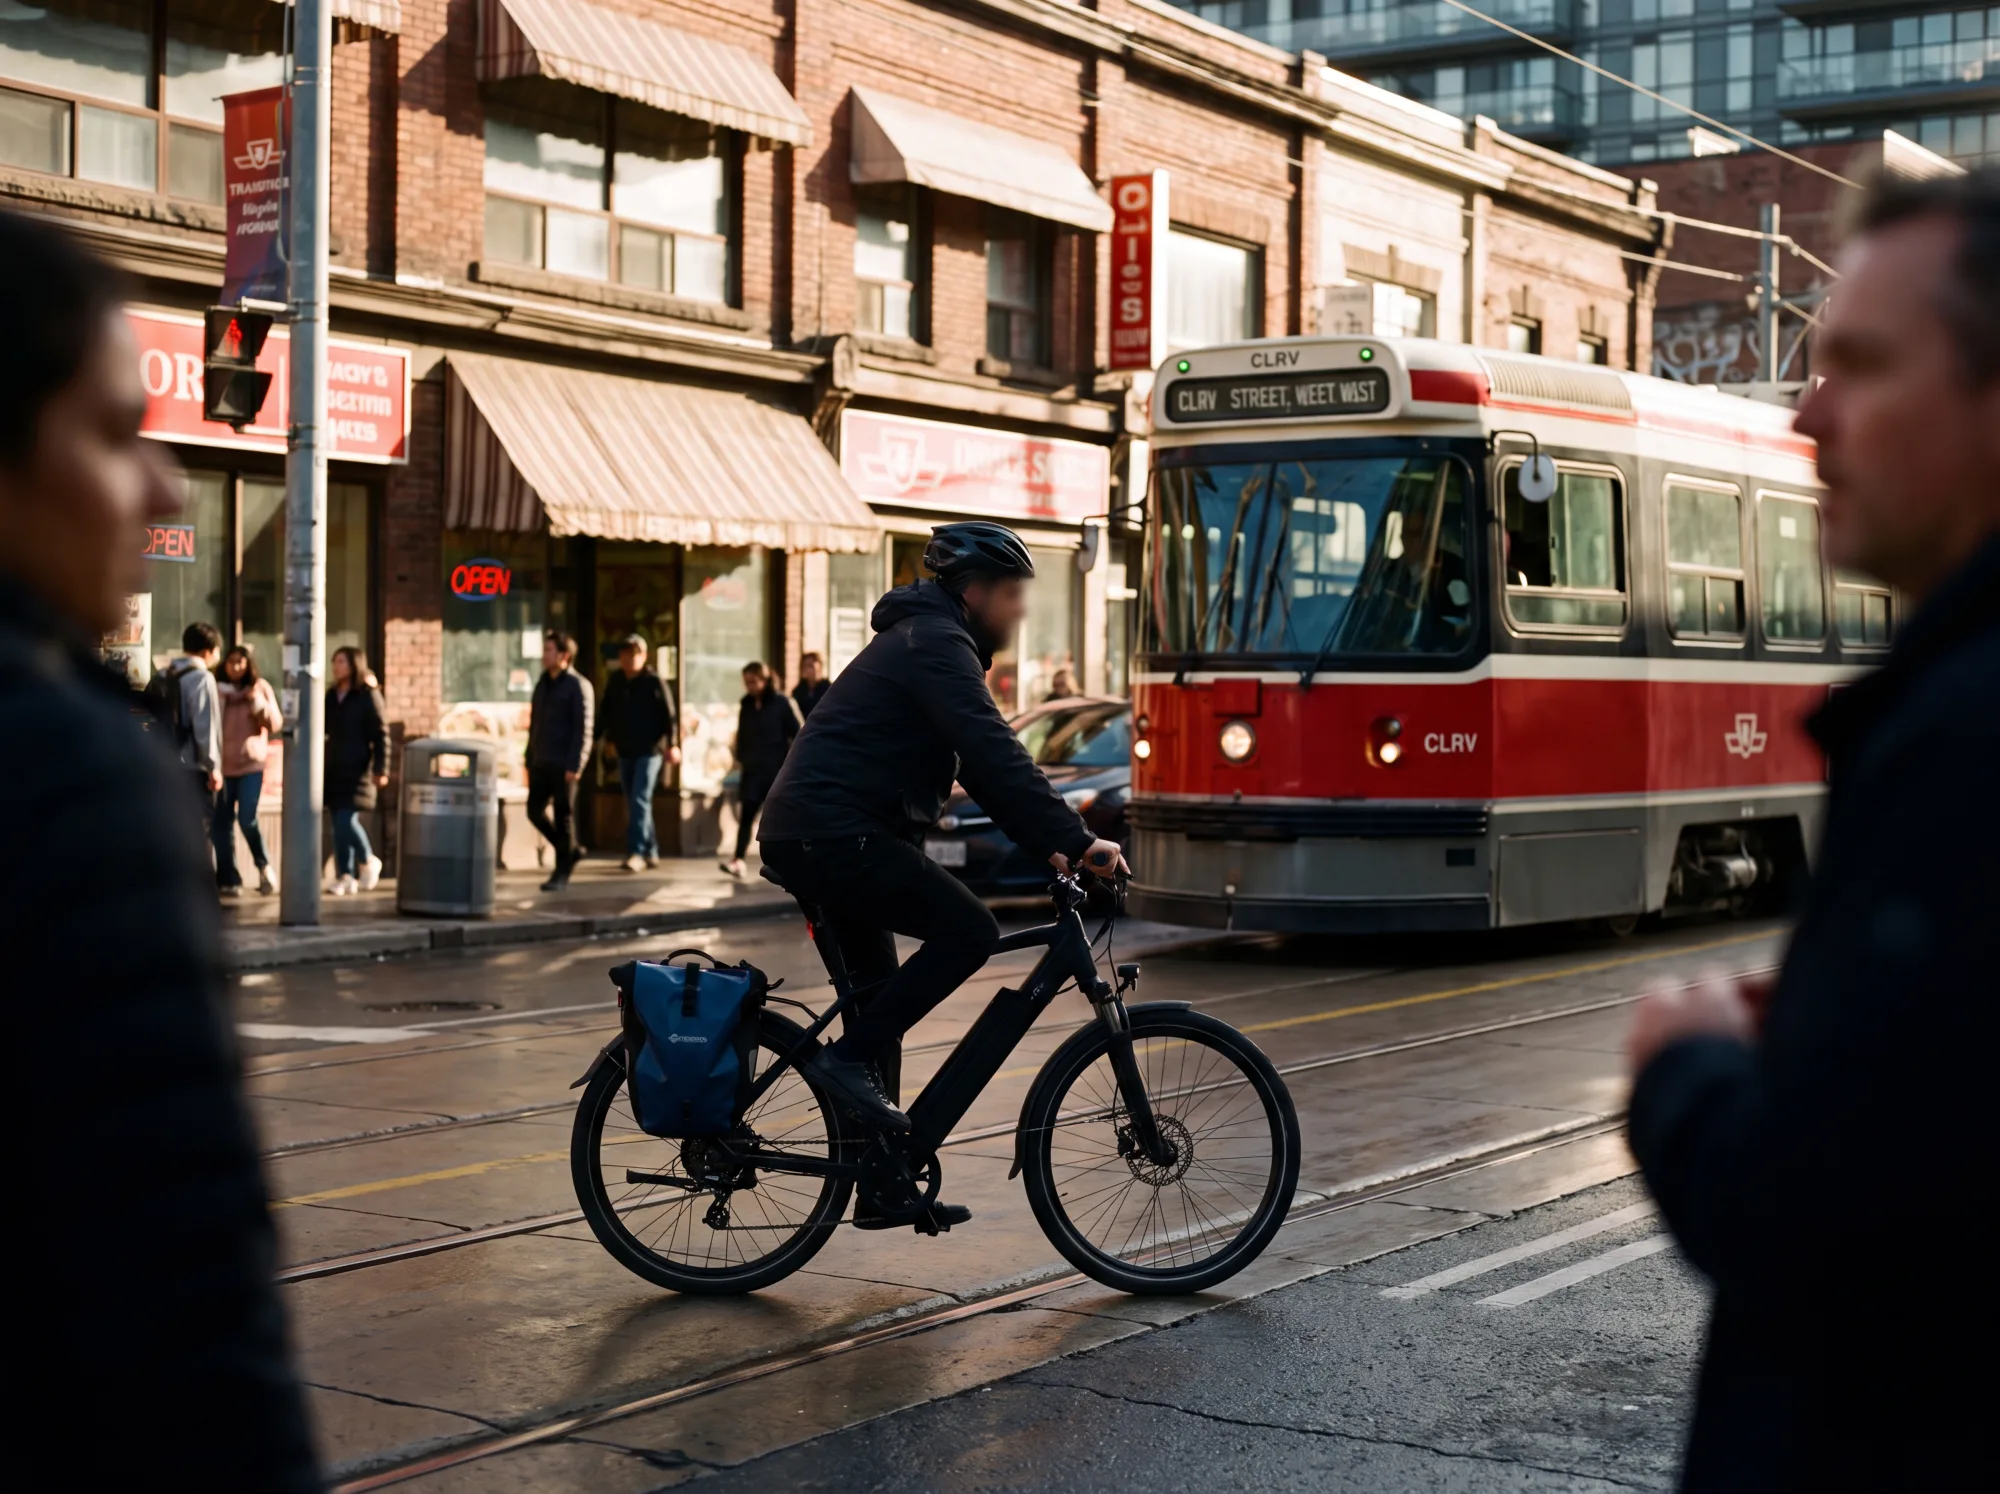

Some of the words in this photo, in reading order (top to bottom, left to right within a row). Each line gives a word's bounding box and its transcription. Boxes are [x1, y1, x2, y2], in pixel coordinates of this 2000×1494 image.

[1251, 350, 1300, 368] CLRV
[1178, 389, 1217, 412] CLRV
[451, 565, 512, 596] OPEN
[1424, 732, 1478, 754] CLRV
